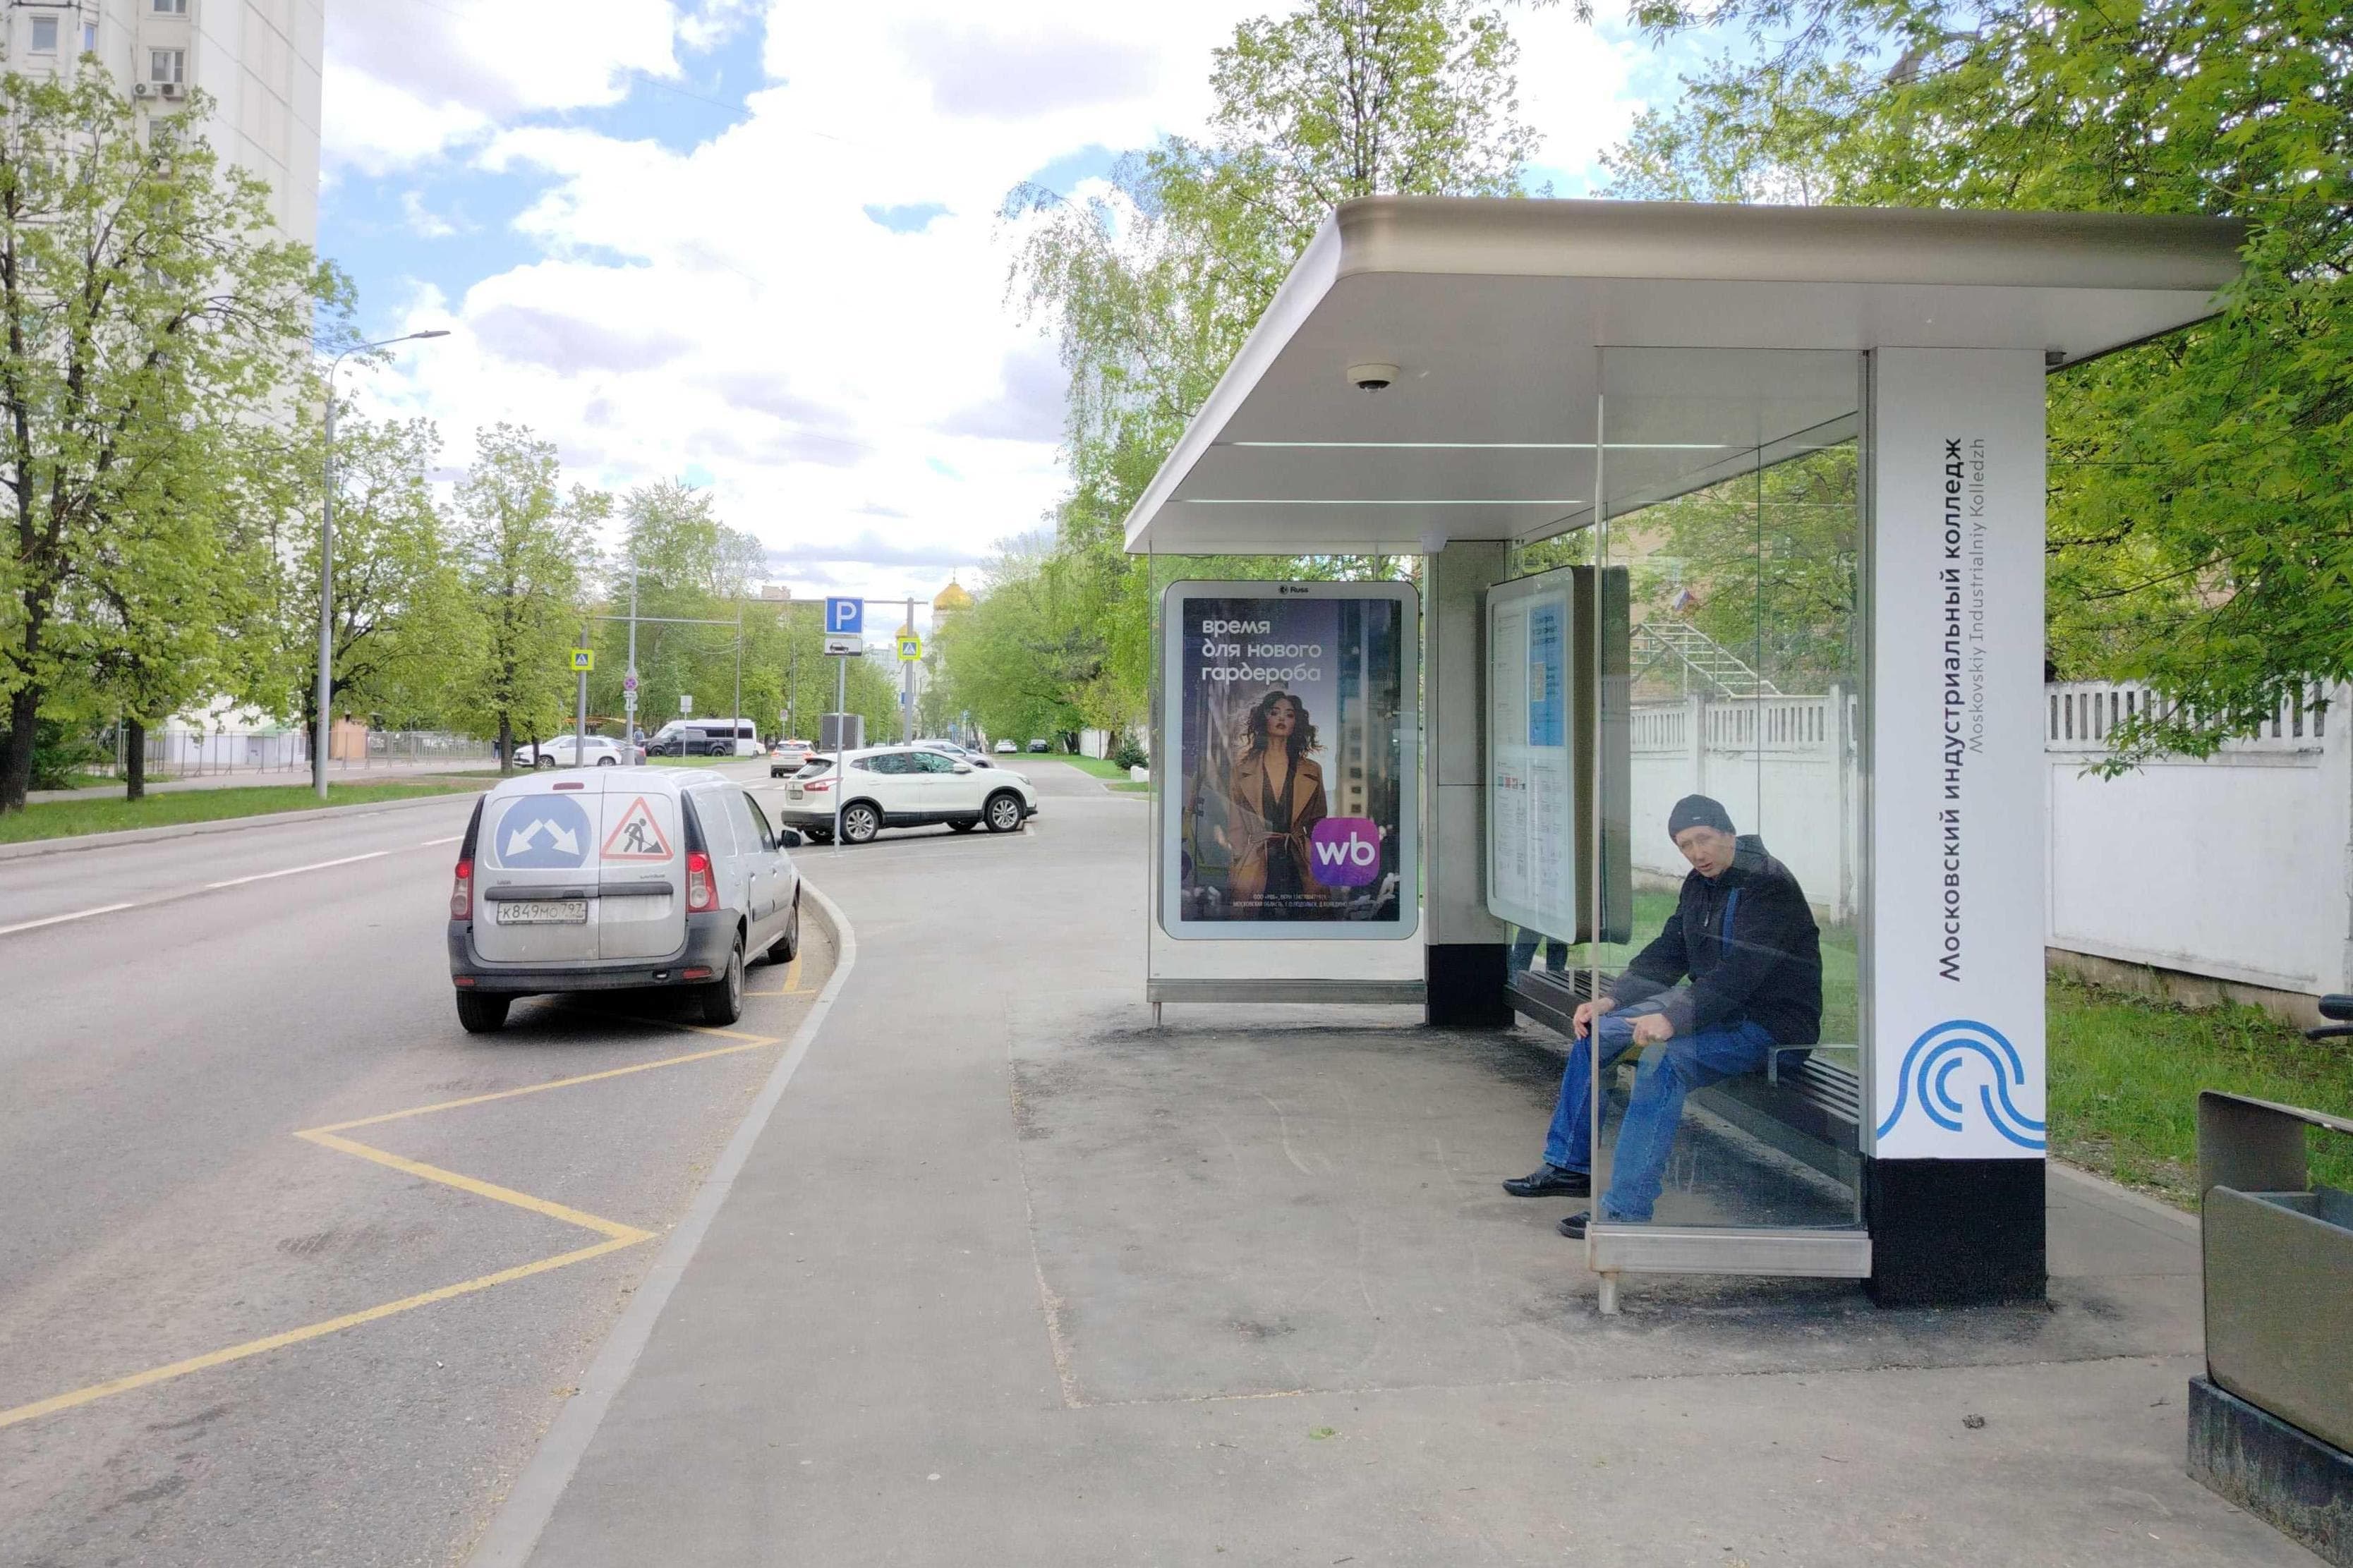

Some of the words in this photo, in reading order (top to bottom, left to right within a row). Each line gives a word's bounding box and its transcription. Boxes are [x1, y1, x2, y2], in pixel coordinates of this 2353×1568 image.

[1945, 438, 1964, 559] колледж
[1968, 438, 1985, 516] Kolledzh
[836, 601, 857, 630] P
[1968, 523, 1987, 641] Industrialniy
[1202, 619, 1270, 638] время
[1202, 638, 1241, 657] для
[1247, 643, 1322, 657] нового
[1202, 662, 1321, 685] гардероба
[1939, 569, 1965, 799] индустриальный
[1968, 647, 1986, 753] Moskovskiy
[1315, 832, 1376, 866] wb
[1939, 809, 1960, 982] Московский
